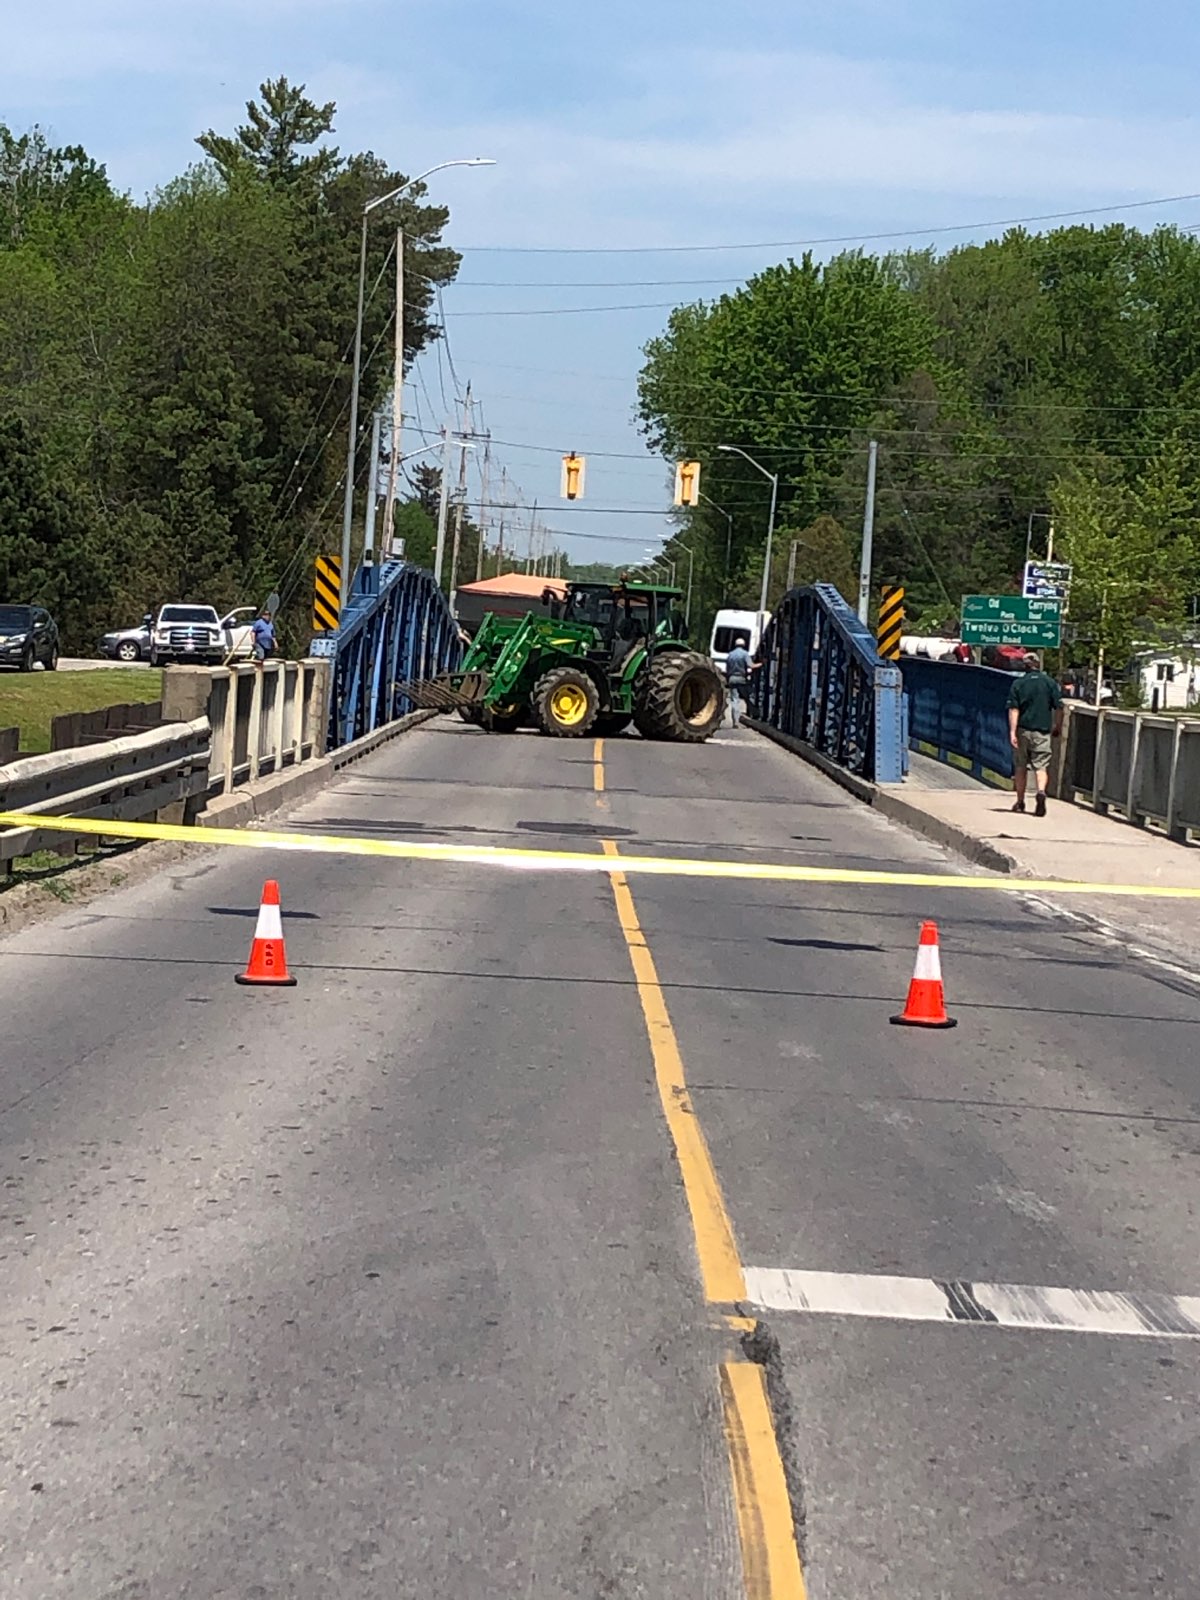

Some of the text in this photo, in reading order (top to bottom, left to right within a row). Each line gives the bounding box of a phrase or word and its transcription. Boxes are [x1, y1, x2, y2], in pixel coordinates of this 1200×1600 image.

[988, 598, 1058, 613] Old Carrying
[964, 622, 999, 633] Twelve
[980, 634, 1021, 644] Point Road
